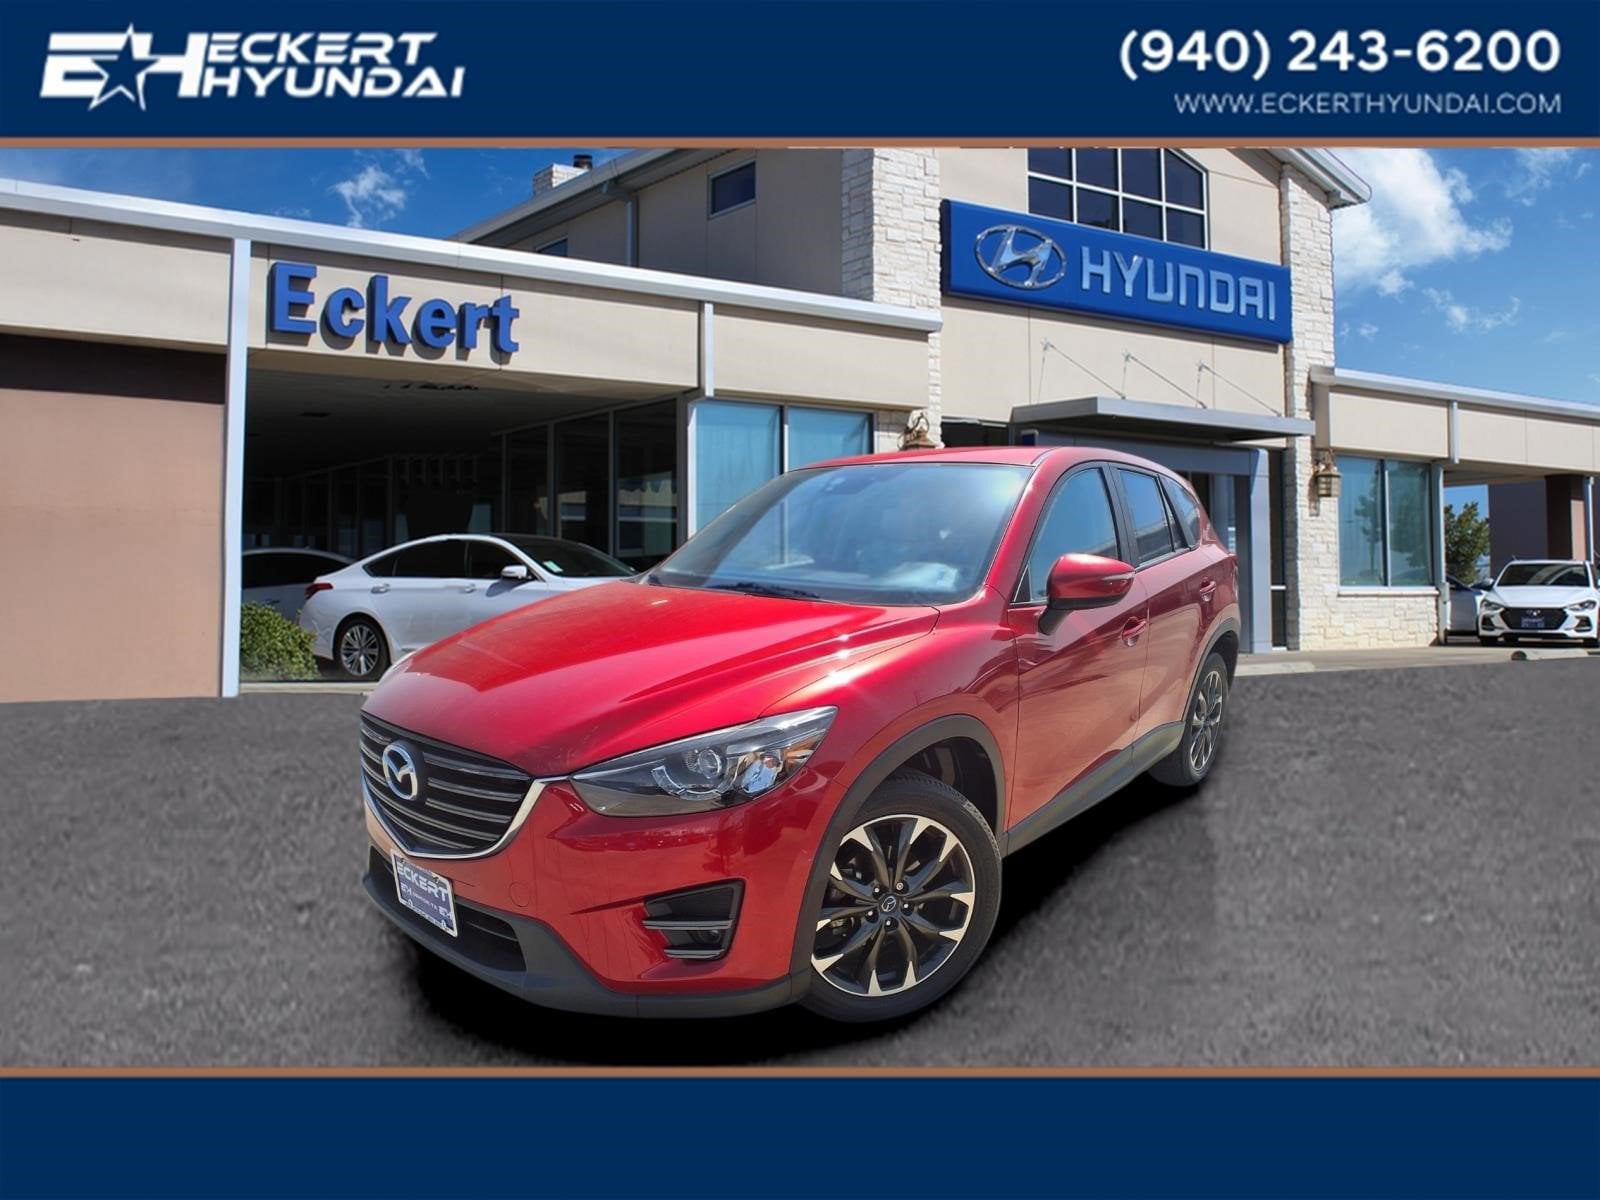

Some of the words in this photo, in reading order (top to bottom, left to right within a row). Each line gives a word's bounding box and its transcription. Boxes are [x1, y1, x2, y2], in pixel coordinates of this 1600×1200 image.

[269, 261, 520, 353] Eckert
[1081, 246, 1276, 321] HYUNDAI
[396, 860, 450, 902] ECKERT
